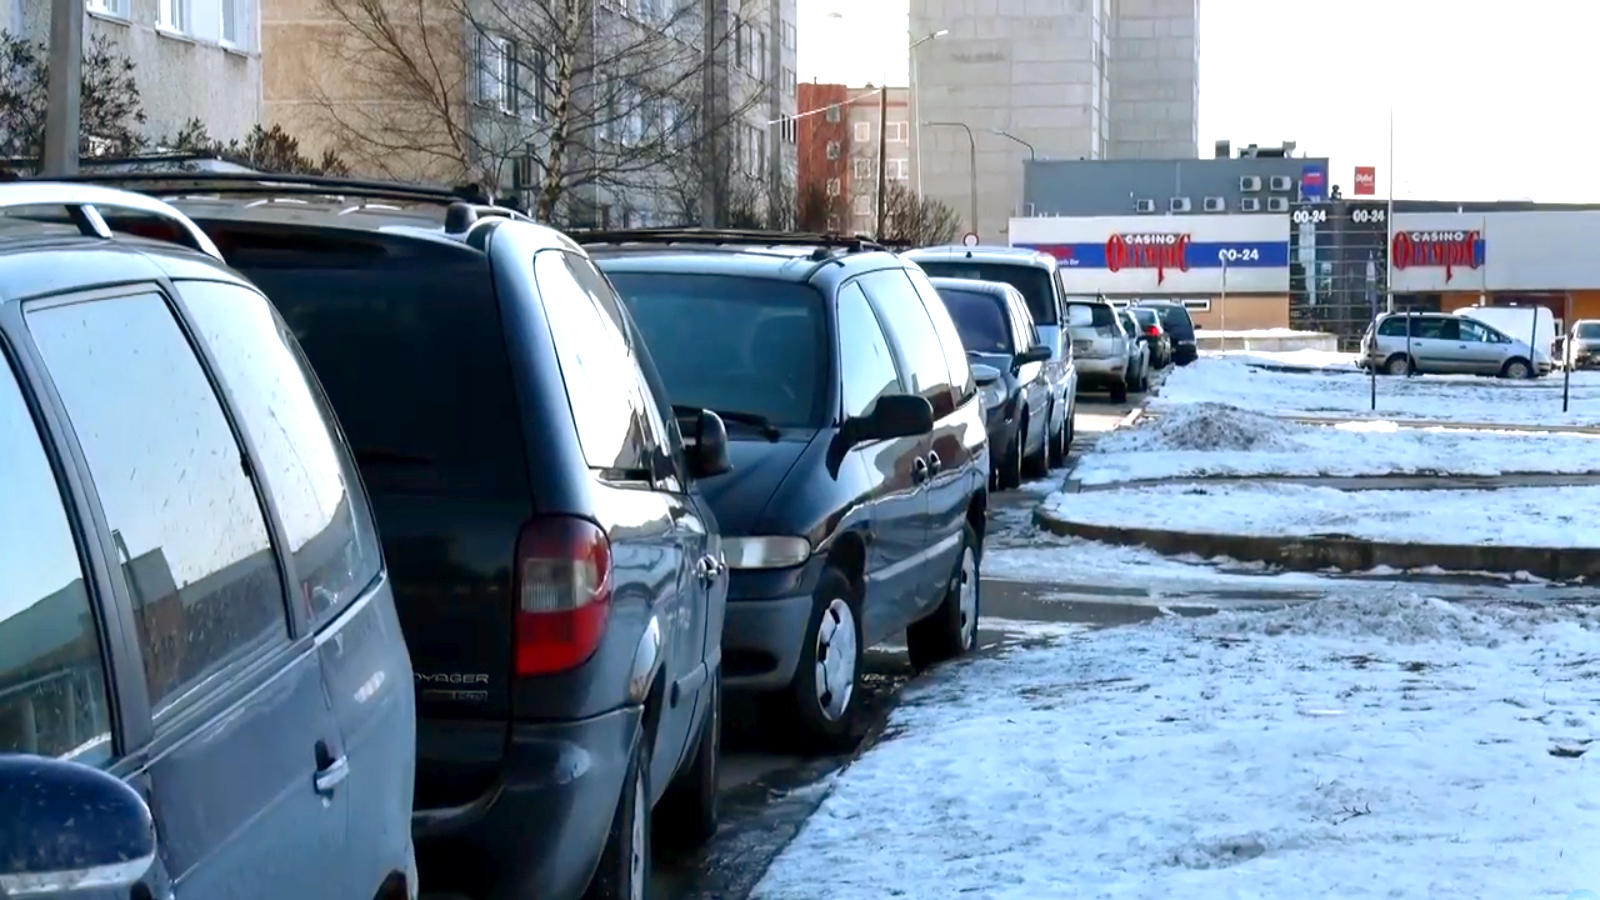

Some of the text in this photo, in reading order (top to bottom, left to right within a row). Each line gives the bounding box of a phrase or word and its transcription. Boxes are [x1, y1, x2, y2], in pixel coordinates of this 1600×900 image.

[1293, 209, 1327, 223] 00-24
[1352, 209, 1385, 223] 00-24
[1125, 233, 1175, 245] CASINO
[1411, 231, 1464, 242] CASINO
[1218, 248, 1259, 262] 00-24
